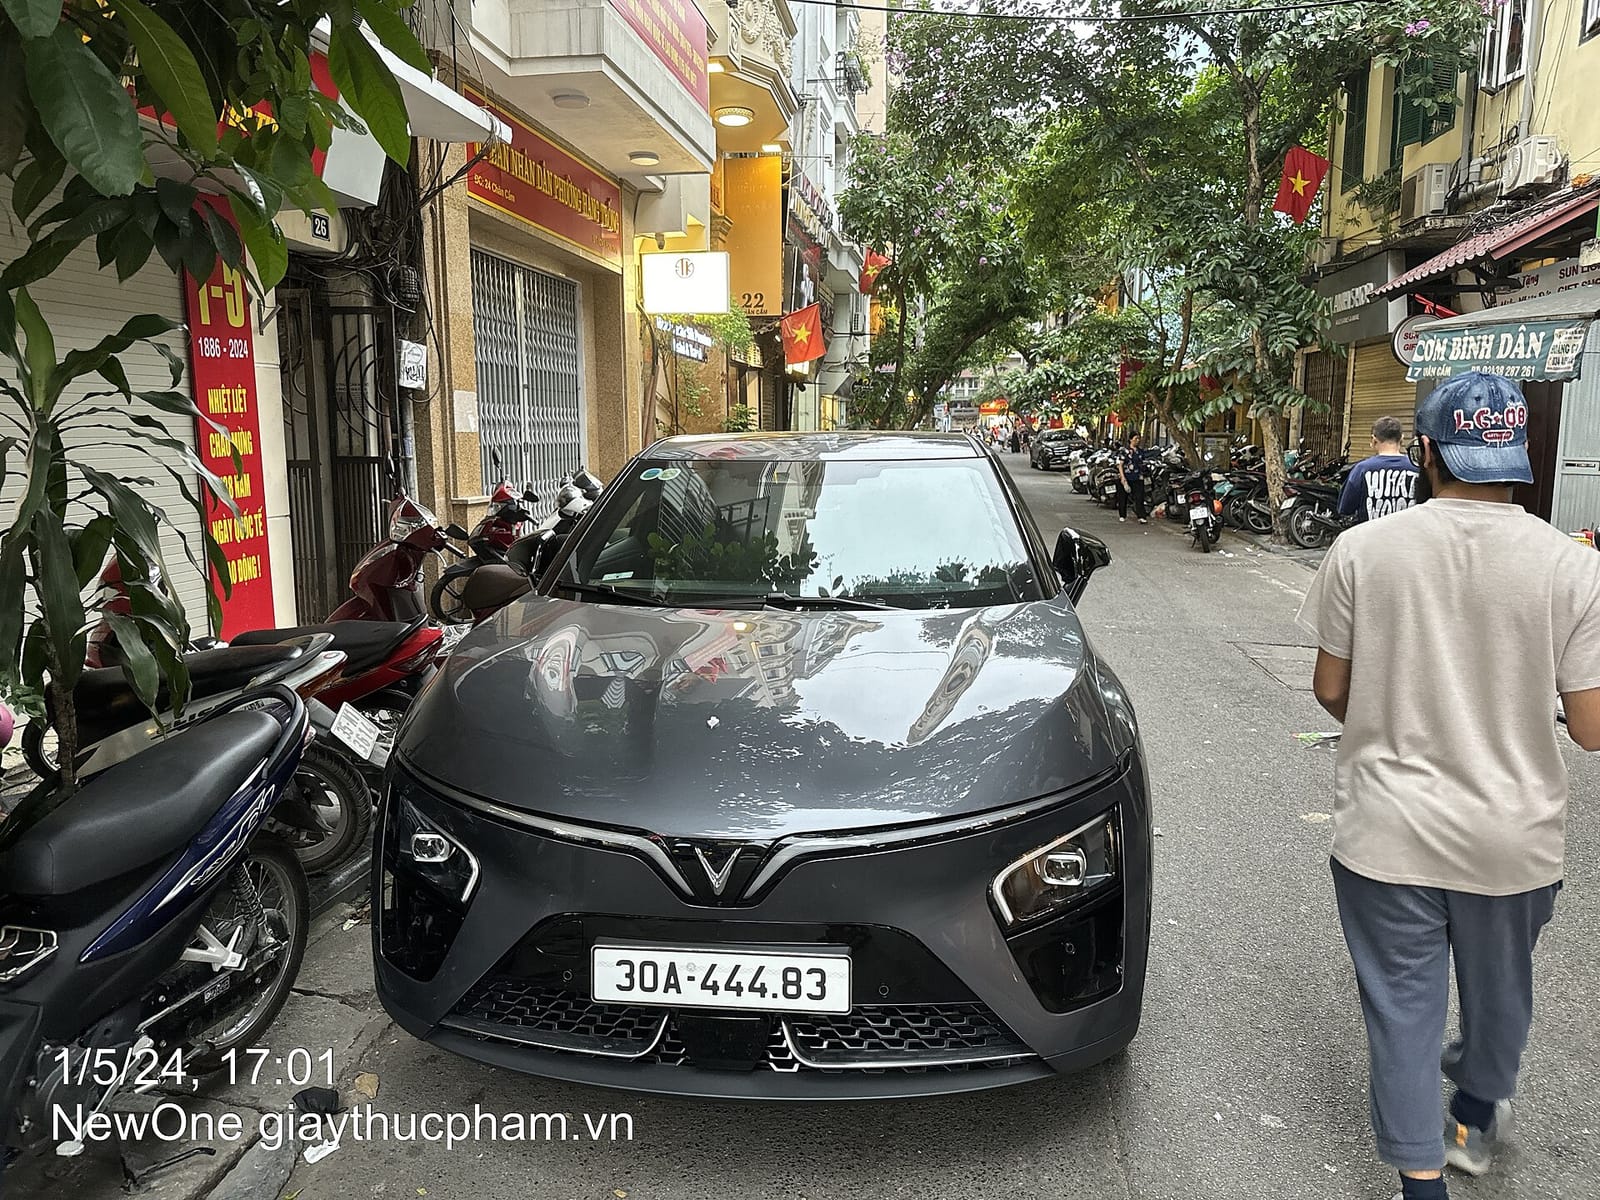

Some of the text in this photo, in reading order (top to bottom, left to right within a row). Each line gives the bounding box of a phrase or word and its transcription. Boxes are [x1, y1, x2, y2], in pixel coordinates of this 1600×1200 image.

[511, 148, 535, 187] NHÂN
[537, 160, 552, 197] DÂN
[314, 219, 327, 236] 26
[1559, 265, 1578, 279] SUN
[742, 292, 764, 308] 22
[199, 337, 221, 357] 1886
[229, 339, 249, 358] 2024
[1403, 343, 1417, 351] GIF
[1412, 335, 1448, 363] CƠM
[1449, 330, 1496, 361] BÌNH
[1496, 325, 1545, 360] DÂN
[1407, 367, 1421, 377] 17
[1505, 366, 1520, 377] 287
[1521, 366, 1536, 377] 261
[208, 384, 247, 418] NHIỆT LIỆT
[1365, 469, 1419, 498] WHAT
[212, 505, 264, 545] NGÀY QUỐC TẾ
[237, 552, 257, 586] ĐỘNG
[615, 959, 827, 1001] 30A-444.83
